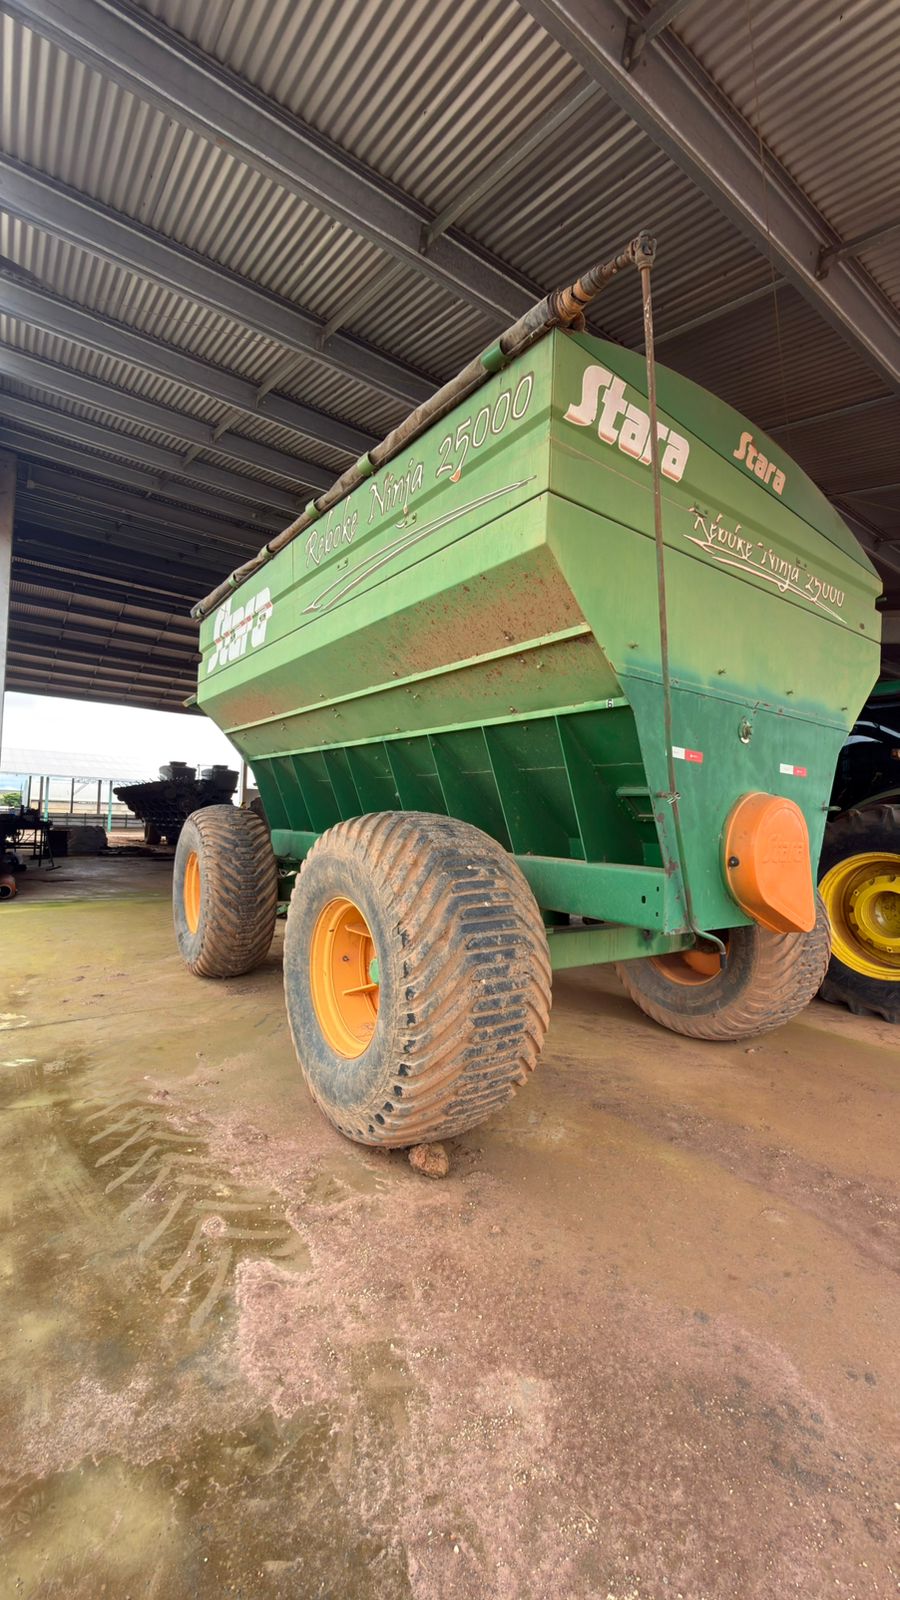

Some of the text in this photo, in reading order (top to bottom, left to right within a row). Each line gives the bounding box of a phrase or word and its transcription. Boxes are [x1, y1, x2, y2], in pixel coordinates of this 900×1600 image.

[367, 459, 425, 528] Ninja
[435, 371, 535, 483] 25000
[563, 364, 691, 483] Stara
[733, 431, 786, 495] Stara
